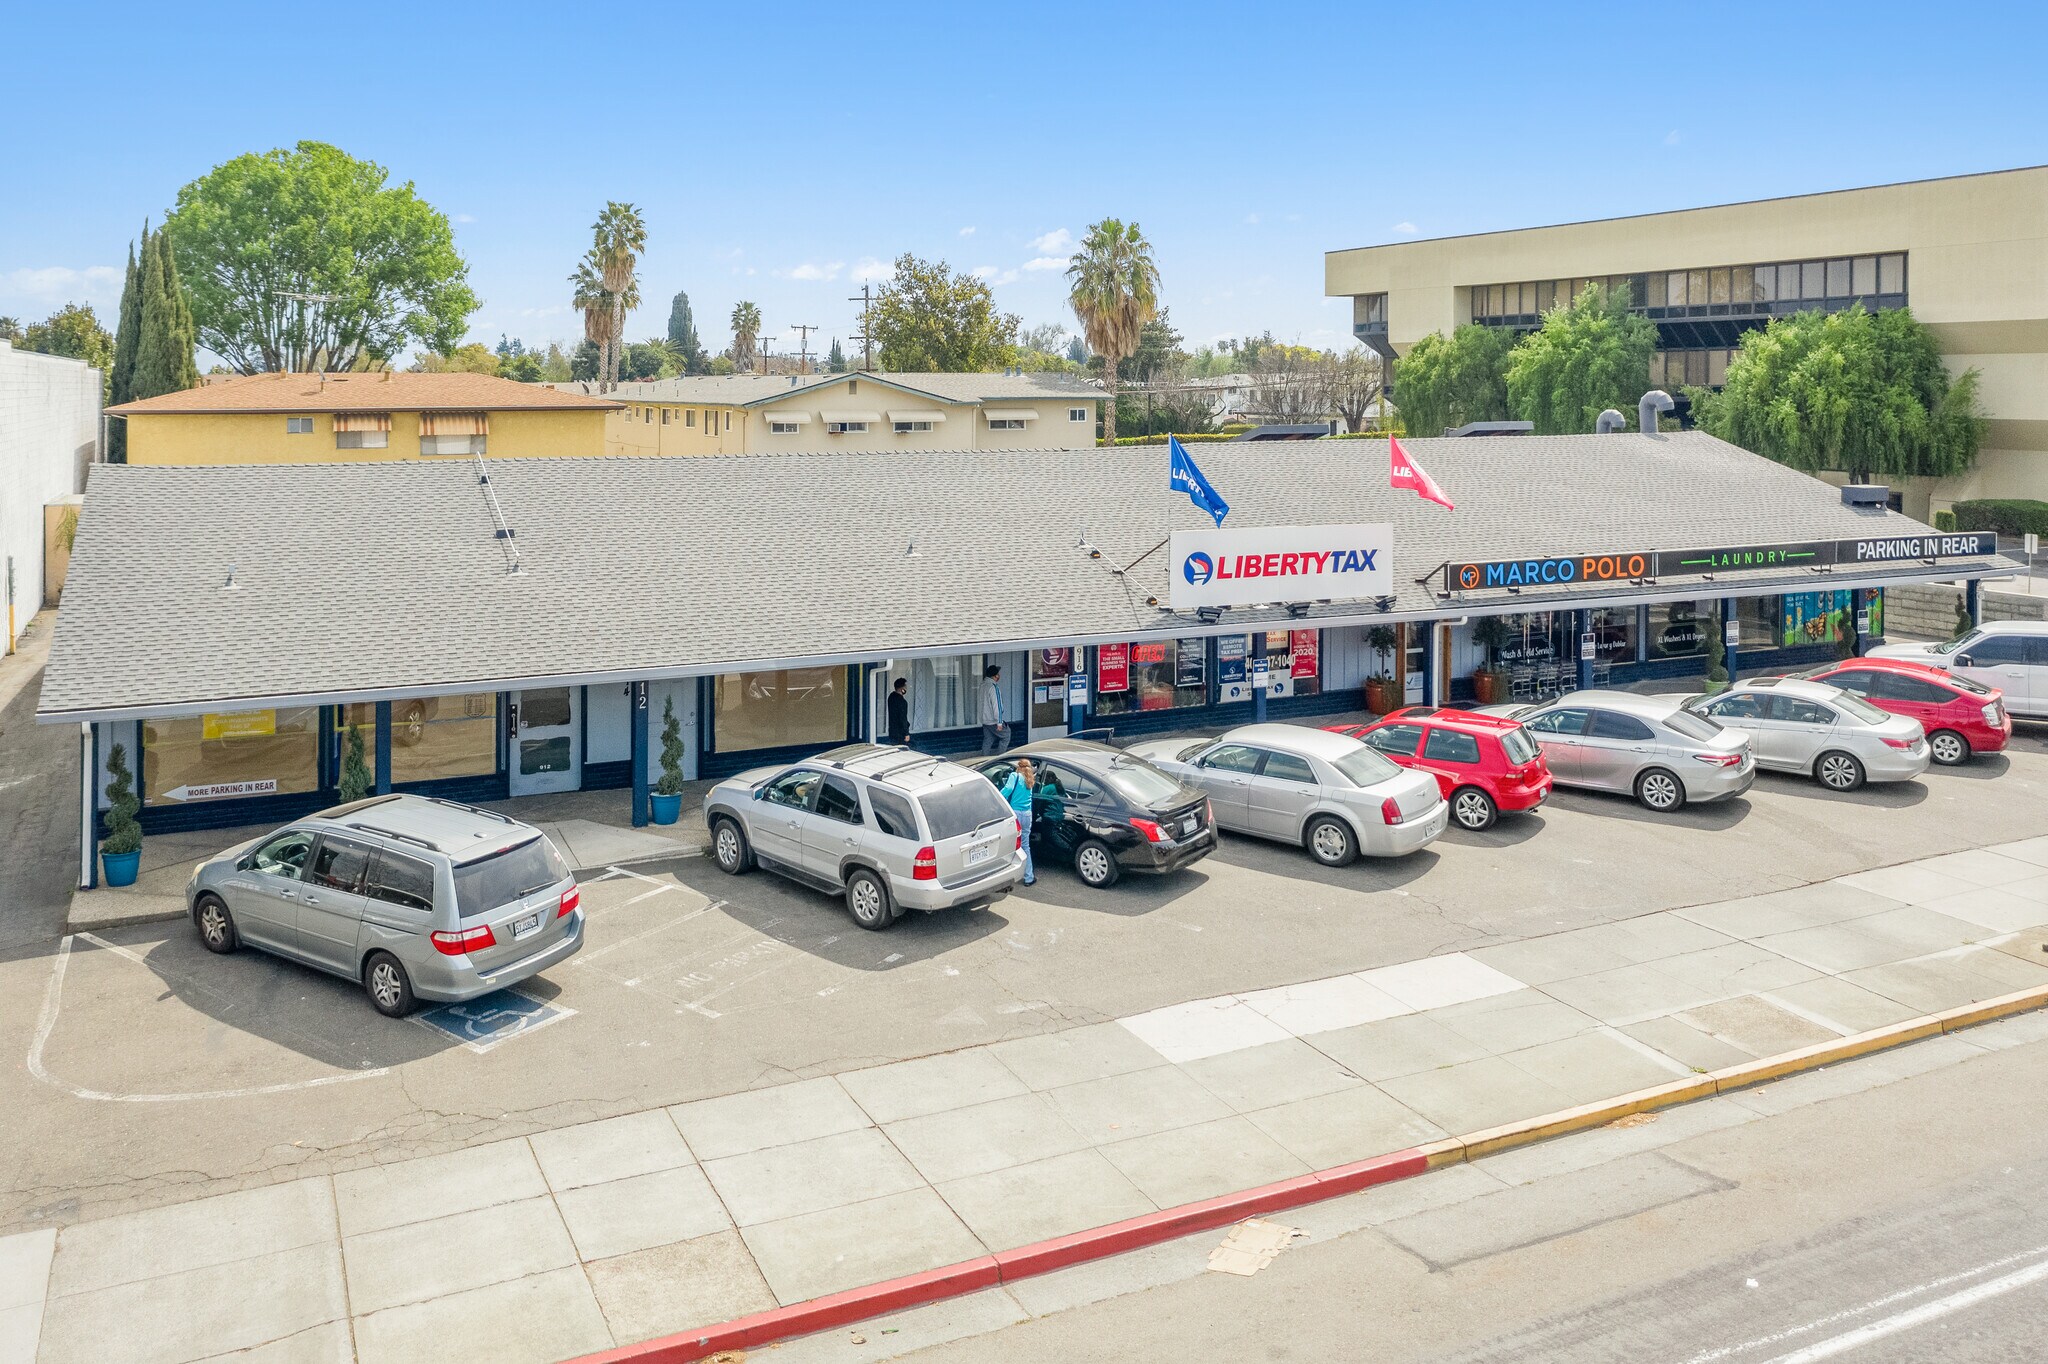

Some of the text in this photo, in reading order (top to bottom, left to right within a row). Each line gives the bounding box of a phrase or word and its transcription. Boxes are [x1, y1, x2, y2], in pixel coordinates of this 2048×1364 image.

[1857, 536, 1979, 559] PARKING IN REAR
[1216, 548, 1378, 580] LIBERTYTAX
[1711, 550, 1787, 567] LAUNDRY
[1486, 555, 1645, 586] MARCO POLO
[1664, 635, 1681, 643] Washers
[1692, 632, 1706, 642] Dryers
[1131, 644, 1165, 662] OPEN
[1294, 648, 1315, 656] 2020.
[1501, 649, 1516, 659] Wash
[1517, 649, 1523, 658] &
[1535, 646, 1554, 656] Service
[187, 781, 275, 797] MORE PARKING IN REAR
